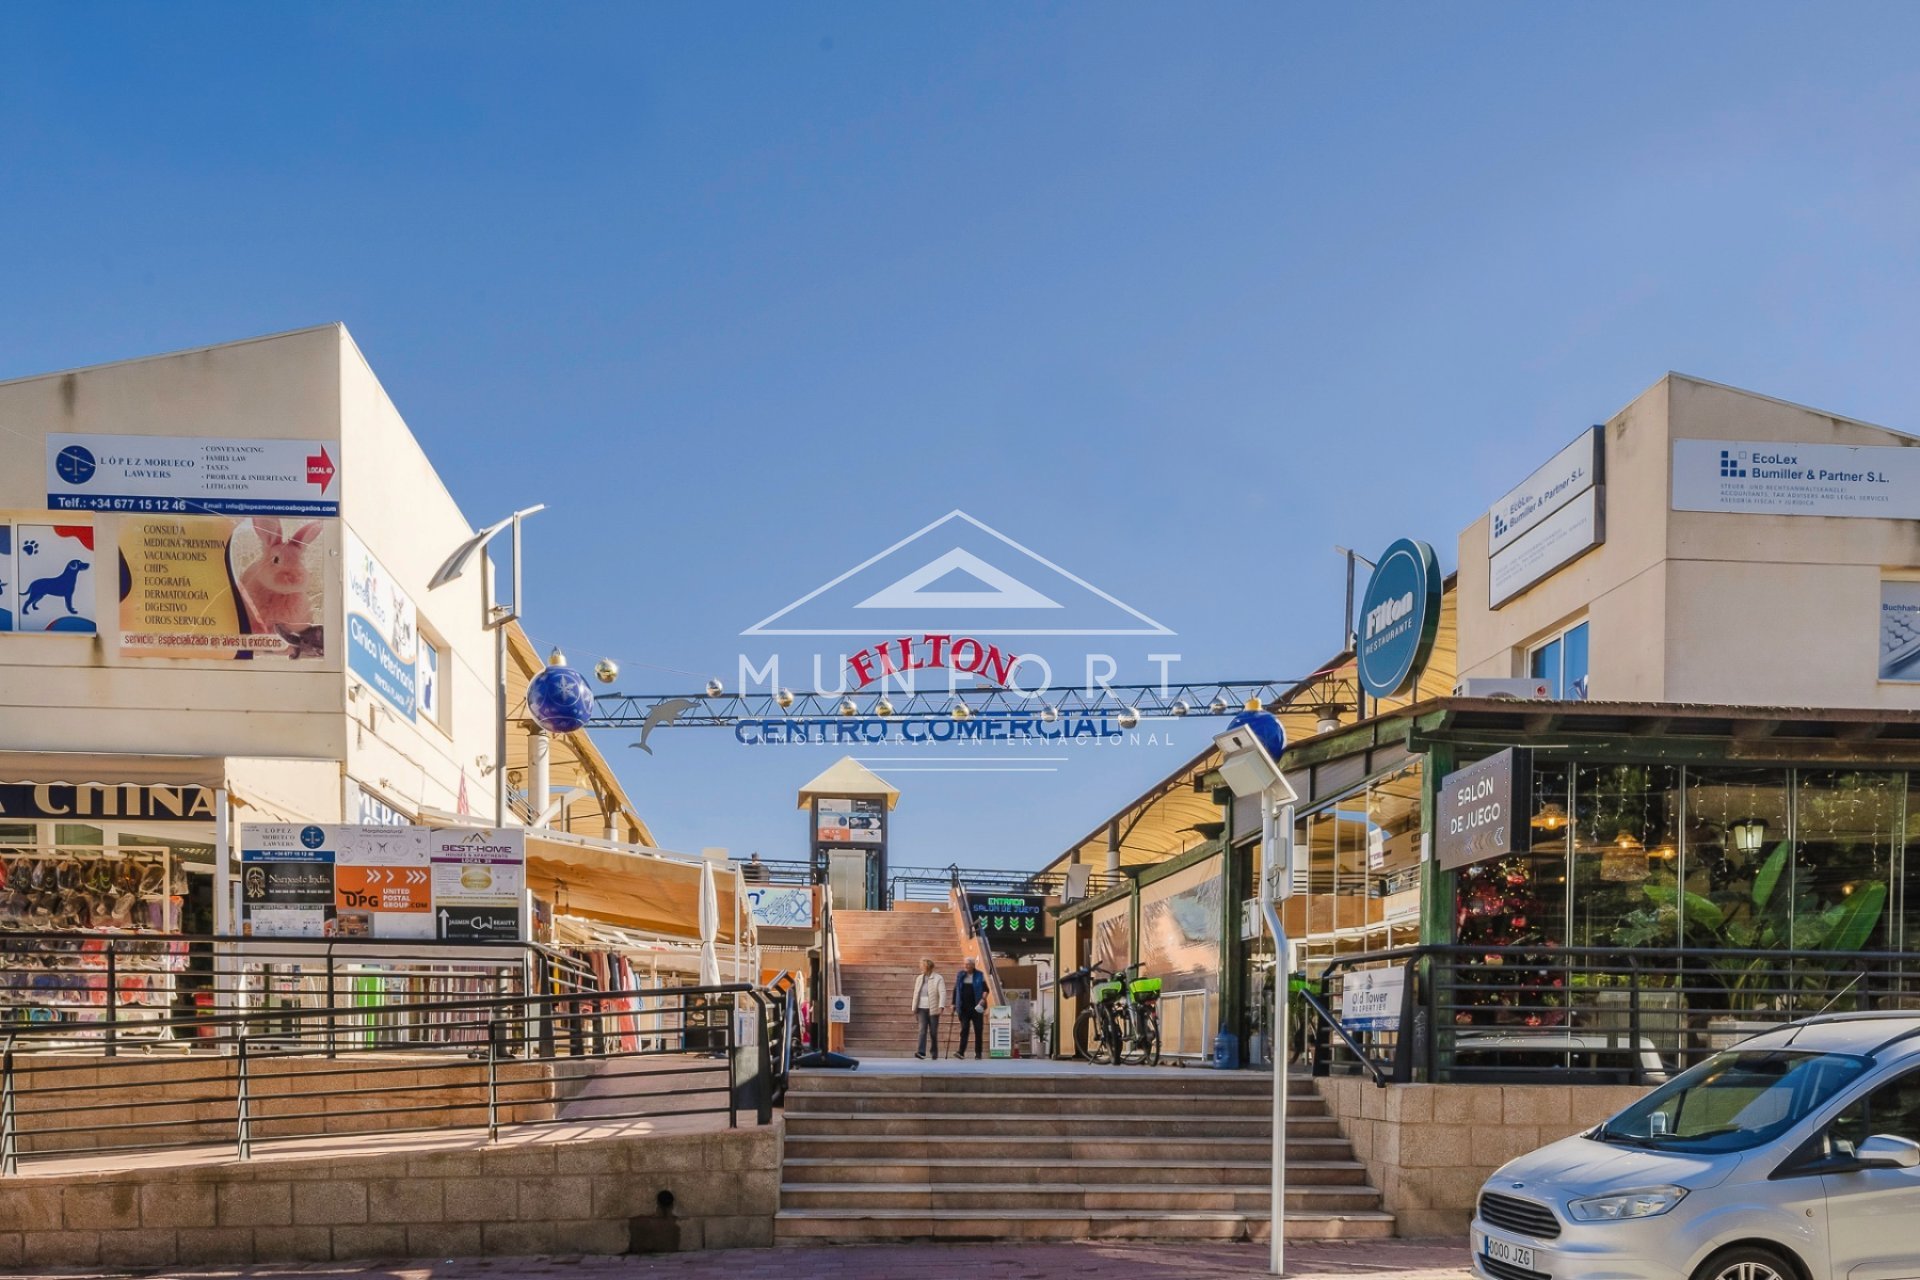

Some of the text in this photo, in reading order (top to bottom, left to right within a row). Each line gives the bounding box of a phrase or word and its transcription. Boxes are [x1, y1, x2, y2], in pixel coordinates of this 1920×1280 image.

[144, 459, 195, 468] MORUECO
[1752, 452, 1797, 465] EcoLex
[124, 470, 171, 479] LAWYERS
[307, 466, 325, 474] LOCAL
[1752, 467, 1890, 483] Bumiller & Partner S.L.
[1544, 478, 1570, 503] Partner
[58, 497, 186, 511] Telf.: +34 677 15 12 46
[144, 538, 226, 549] MEDICINA PREVENTIVA
[144, 551, 207, 561] VACUNACIONES
[144, 564, 169, 573] CHIPS
[144, 603, 187, 612] DIGESTIVO
[144, 616, 216, 626] OTROS SERVICIOS
[1365, 591, 1413, 640] Filton
[158, 635, 209, 648] especializado
[1365, 617, 1413, 656] RESTAURANTE
[847, 634, 1018, 689] FILTON
[378, 643, 415, 695] Veterinaria
[735, 708, 1123, 745] CENTRO COMERCIAL
[1457, 776, 1494, 807] SALÓN
[1450, 802, 1501, 835] DE JUEGO
[442, 845, 512, 854] BEST-HOME
[338, 887, 379, 908] UPG
[1352, 992, 1388, 1005] Old Tower
[1512, 1247, 1530, 1266] JZG
